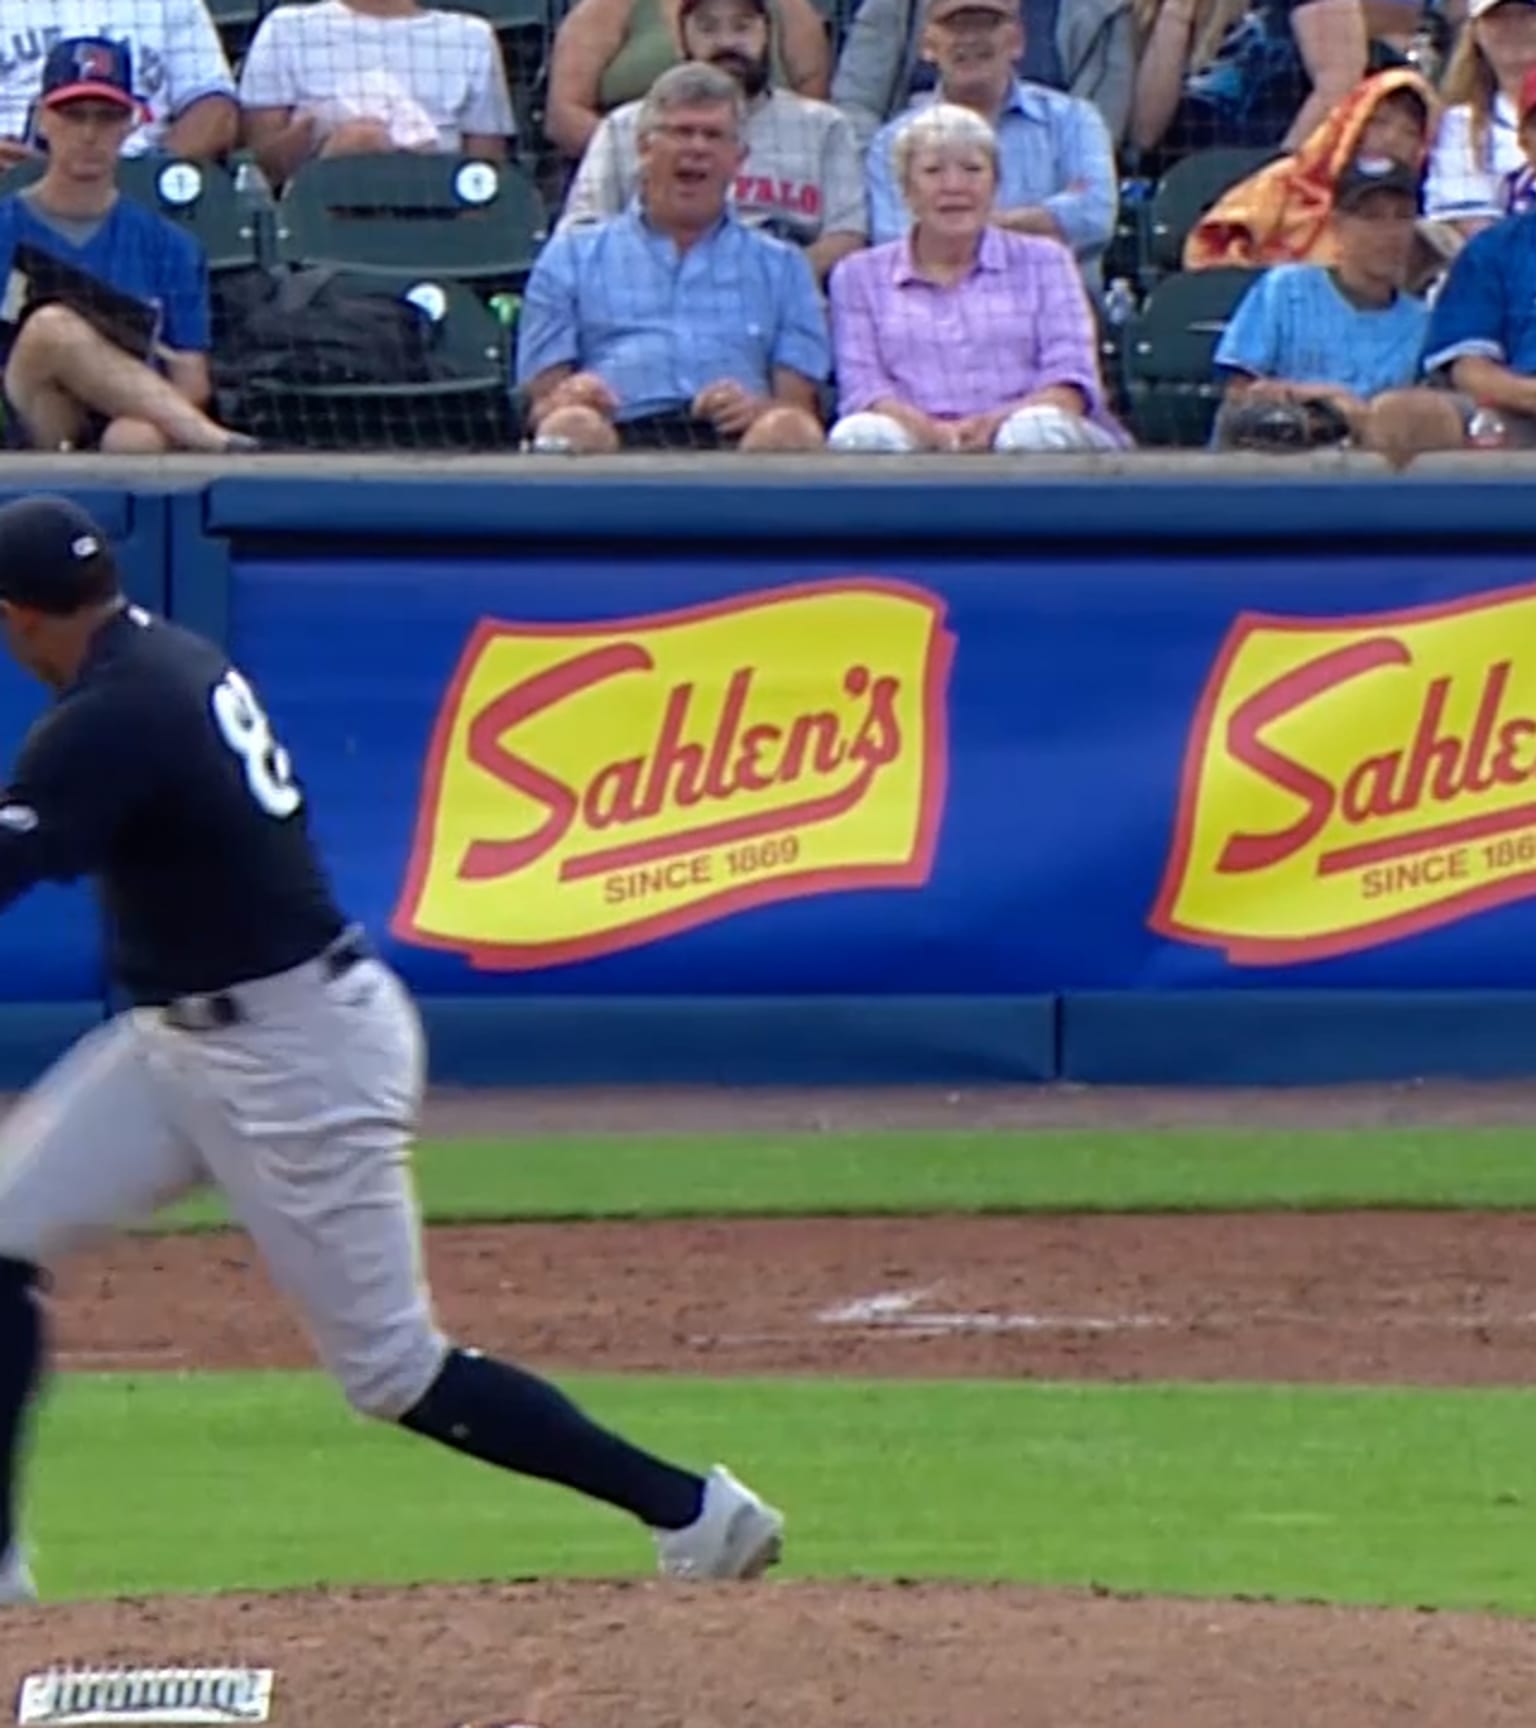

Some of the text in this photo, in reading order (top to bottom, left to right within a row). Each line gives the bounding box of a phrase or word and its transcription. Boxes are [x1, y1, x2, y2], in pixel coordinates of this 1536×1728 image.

[457, 640, 901, 881] Sahlen's
[604, 836, 800, 904] SINCE 1869
[1360, 848, 1470, 900] SINCE
